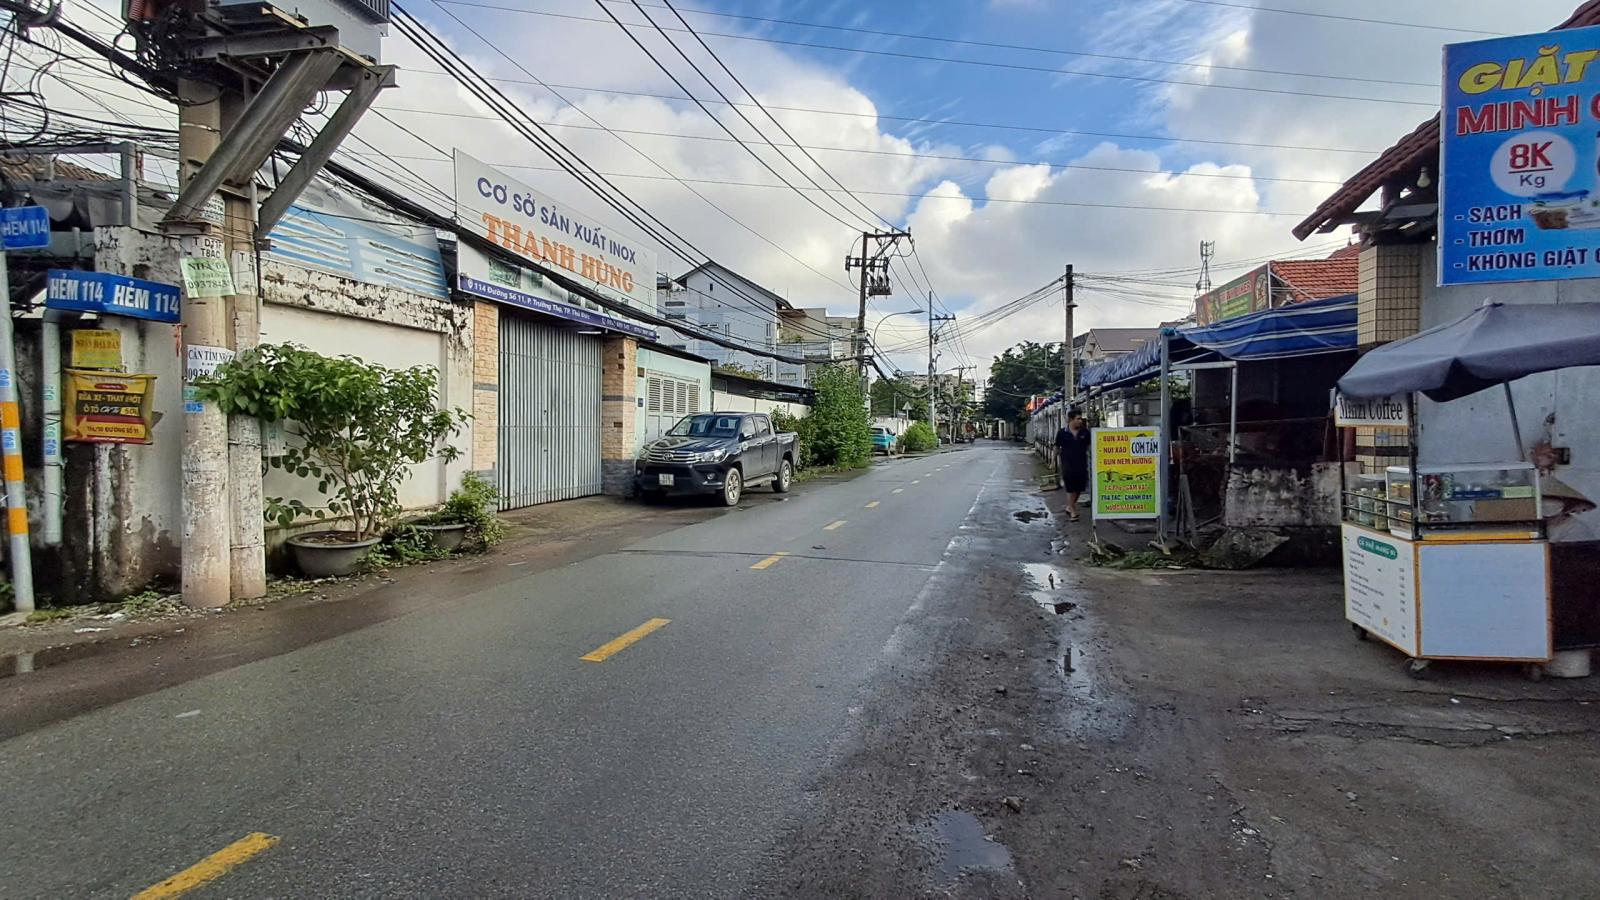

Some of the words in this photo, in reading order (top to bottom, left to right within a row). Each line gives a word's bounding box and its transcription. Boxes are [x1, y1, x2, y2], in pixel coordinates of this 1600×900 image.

[1458, 43, 1600, 96] GIẶT
[1457, 95, 1578, 136] MINH
[1508, 141, 1553, 170] 8K
[1519, 174, 1545, 188] Kg
[477, 177, 508, 204] CƠ
[513, 192, 536, 217] SỞ
[540, 205, 570, 234] SẢN
[574, 222, 606, 250] XUẤT
[609, 240, 636, 264] INOX
[1469, 204, 1522, 226] SẠCH
[1469, 227, 1524, 247] THƠM
[482, 211, 575, 273] THANH
[581, 253, 634, 293] HÙNG
[1468, 251, 1537, 271] KHÔNG
[1543, 246, 1588, 269] GIẶT
[49, 272, 79, 301] HẺM
[82, 280, 104, 302] 114
[113, 280, 150, 310] HẺM
[155, 292, 180, 315] 114
[474, 282, 486, 292] 114
